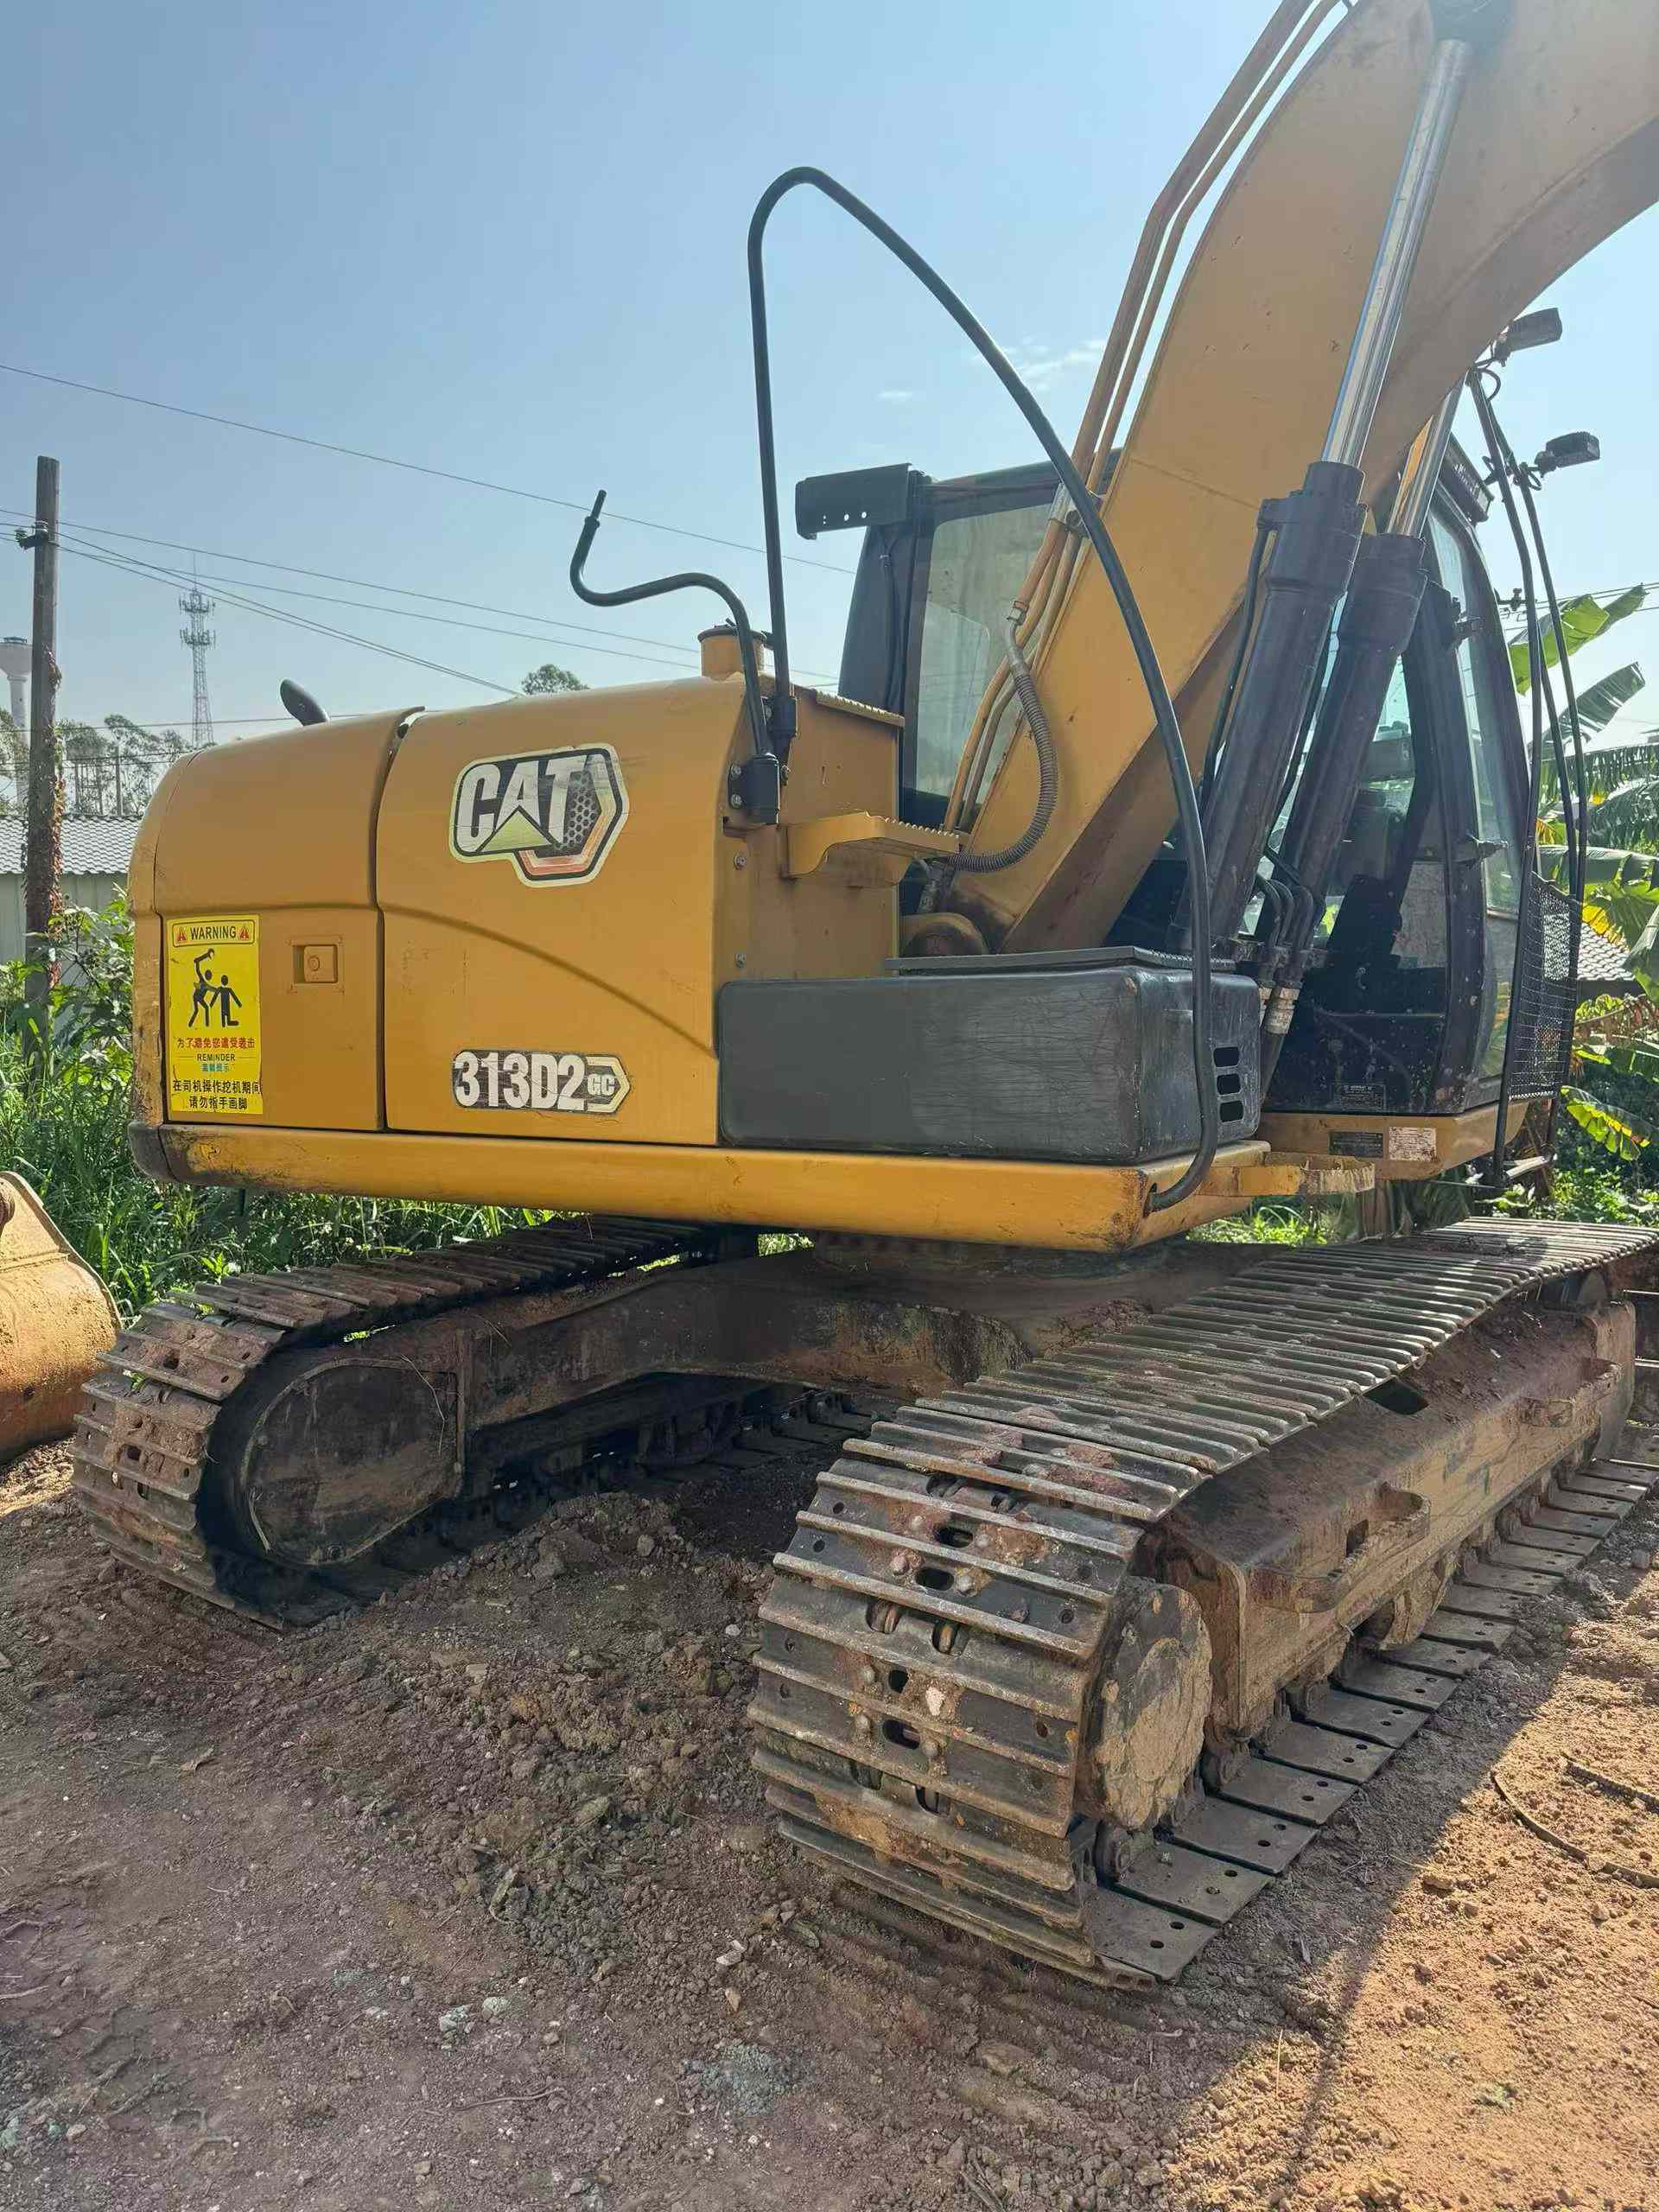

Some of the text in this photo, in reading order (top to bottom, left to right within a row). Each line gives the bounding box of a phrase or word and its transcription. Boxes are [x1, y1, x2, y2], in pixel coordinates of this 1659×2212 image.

[455, 753, 588, 853] CAT
[189, 925, 237, 940] WARNING
[196, 1053, 236, 1062] REMINDER
[173, 1079, 263, 1094] 在司机操作挖机期间
[454, 1051, 615, 1111] 313D2 GC
